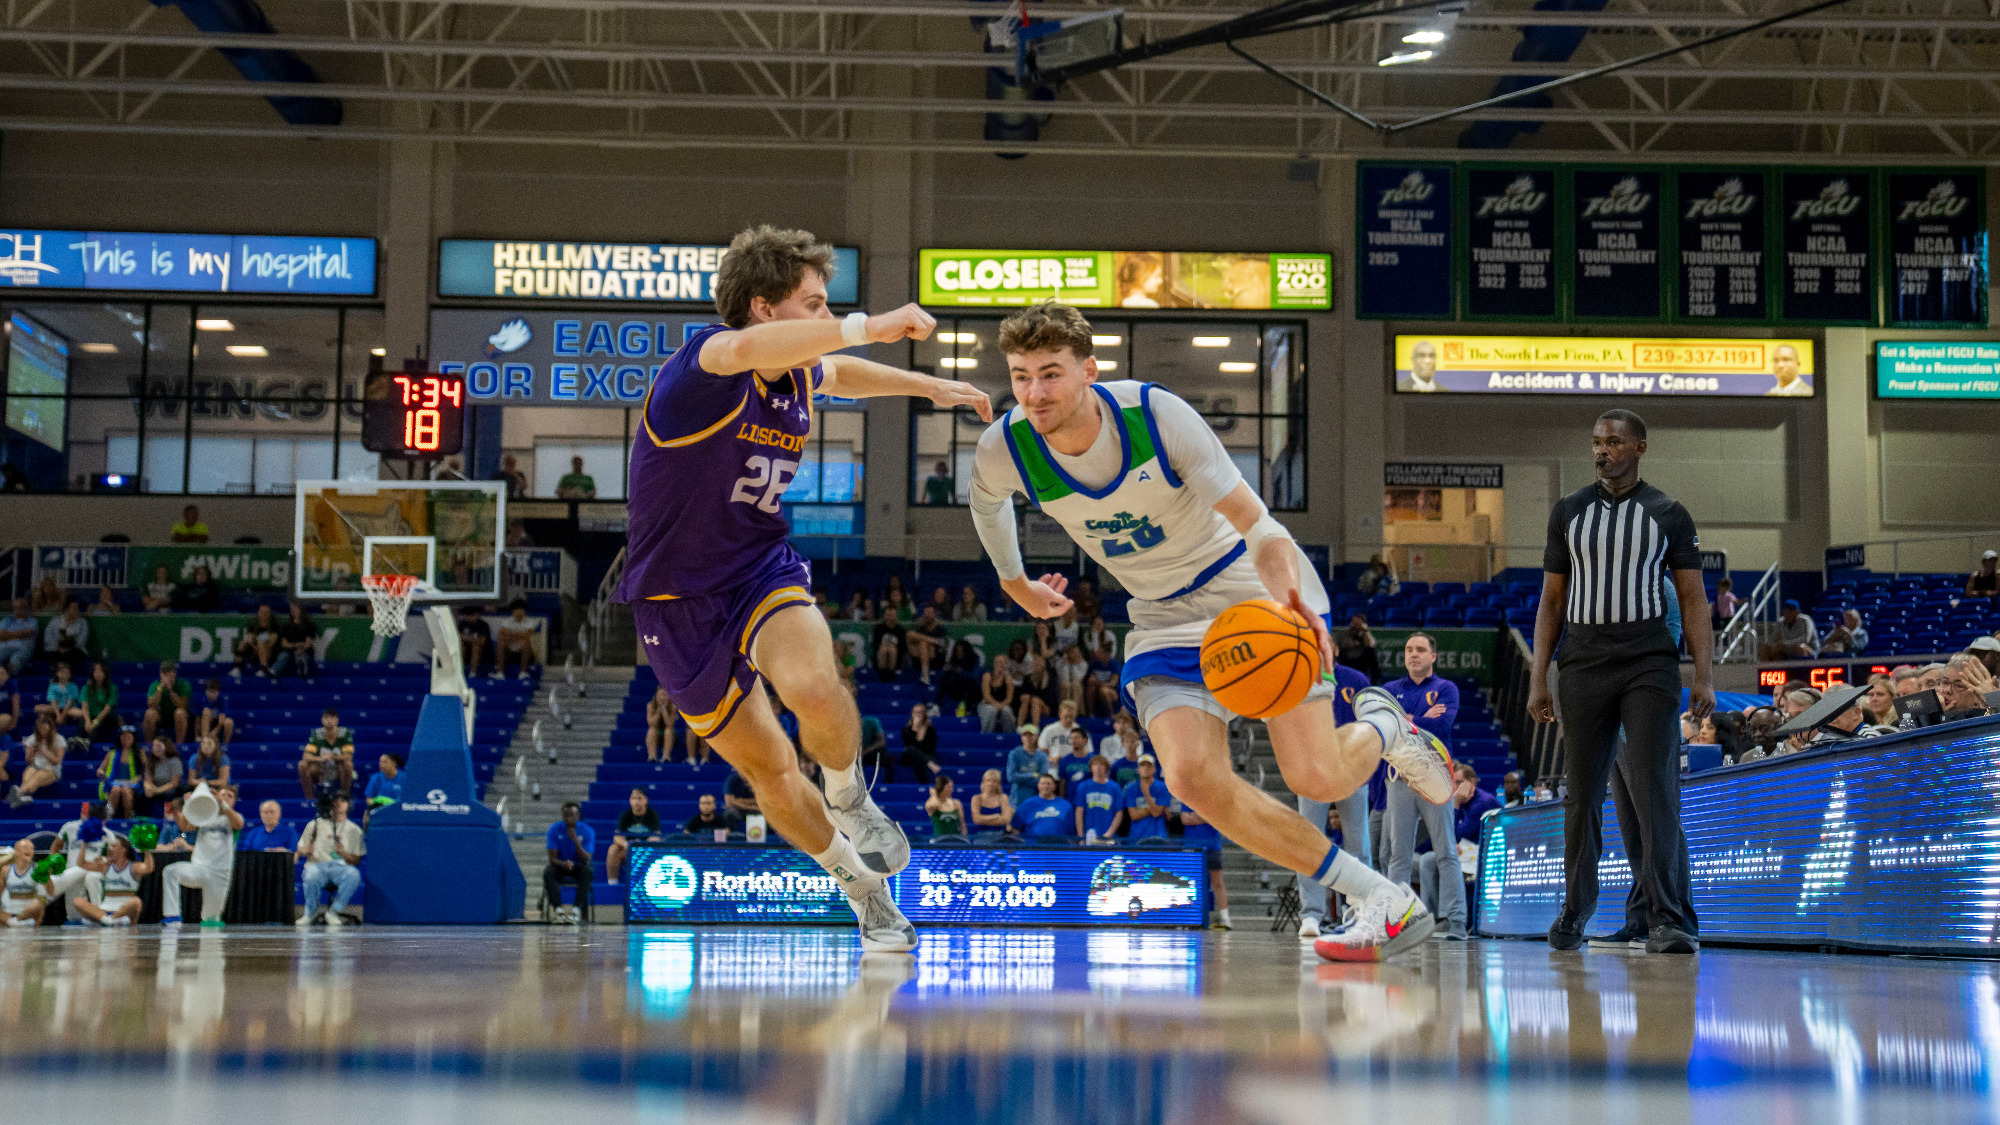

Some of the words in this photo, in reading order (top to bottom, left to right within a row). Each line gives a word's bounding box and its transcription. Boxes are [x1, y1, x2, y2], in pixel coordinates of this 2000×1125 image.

[1390, 219, 1422, 232] NCAA
[1368, 231, 1446, 246] TOURNAMENT
[1492, 231, 1532, 248] NCAA
[1597, 232, 1637, 249] NCAA
[1701, 234, 1741, 251] NCAA
[1807, 235, 1847, 252] NCAA
[1914, 236, 1954, 253] NCAA
[1368, 251, 1400, 266] 2025
[1472, 248, 1551, 262] TOURNAMENT
[1578, 249, 1656, 264] TOURNAMENT
[1682, 250, 1762, 265] TOURNAMENT
[1787, 252, 1867, 267] TOURNAMENT
[1895, 253, 1976, 268] TOURNAMENT
[69, 240, 137, 275] This
[152, 241, 174, 276] is
[189, 248, 230, 291] my
[242, 242, 352, 289] hospital.
[1277, 263, 1326, 273] NAPLES
[934, 259, 1064, 290] CLOSER
[1277, 273, 1327, 289] ZOO
[495, 269, 701, 299] FOUNDATION
[553, 319, 704, 358] EAGL
[1469, 349, 1489, 360] The
[1494, 349, 1531, 360] North
[1535, 350, 1560, 361] Law
[1564, 350, 1599, 362] Firm,
[1603, 350, 1627, 361] P.A.
[1643, 350, 1755, 363] 239-337-1191
[1880, 346, 1898, 357] Get
[1908, 346, 1945, 360] Special
[1947, 347, 1974, 358] FGCU
[1976, 347, 1999, 358] Rate
[1895, 361, 1924, 373] Make
[1934, 362, 1993, 374] Reservation
[1488, 372, 1574, 389] Accident
[1578, 373, 1594, 389] &
[1601, 373, 1654, 392] Injury
[1659, 374, 1719, 391] Cases
[1889, 380, 1916, 390] Proud
[1973, 381, 1999, 391] FGCU
[394, 377, 461, 408] 7:34
[405, 409, 440, 450] 18
[62, 549, 96, 569] KK
[1760, 671, 1787, 686] FGCU
[919, 869, 949, 883] Bus
[951, 869, 1016, 883] Charters
[1018, 870, 1056, 883] from
[919, 885, 952, 906] 20
[970, 885, 1057, 909] 20,000
